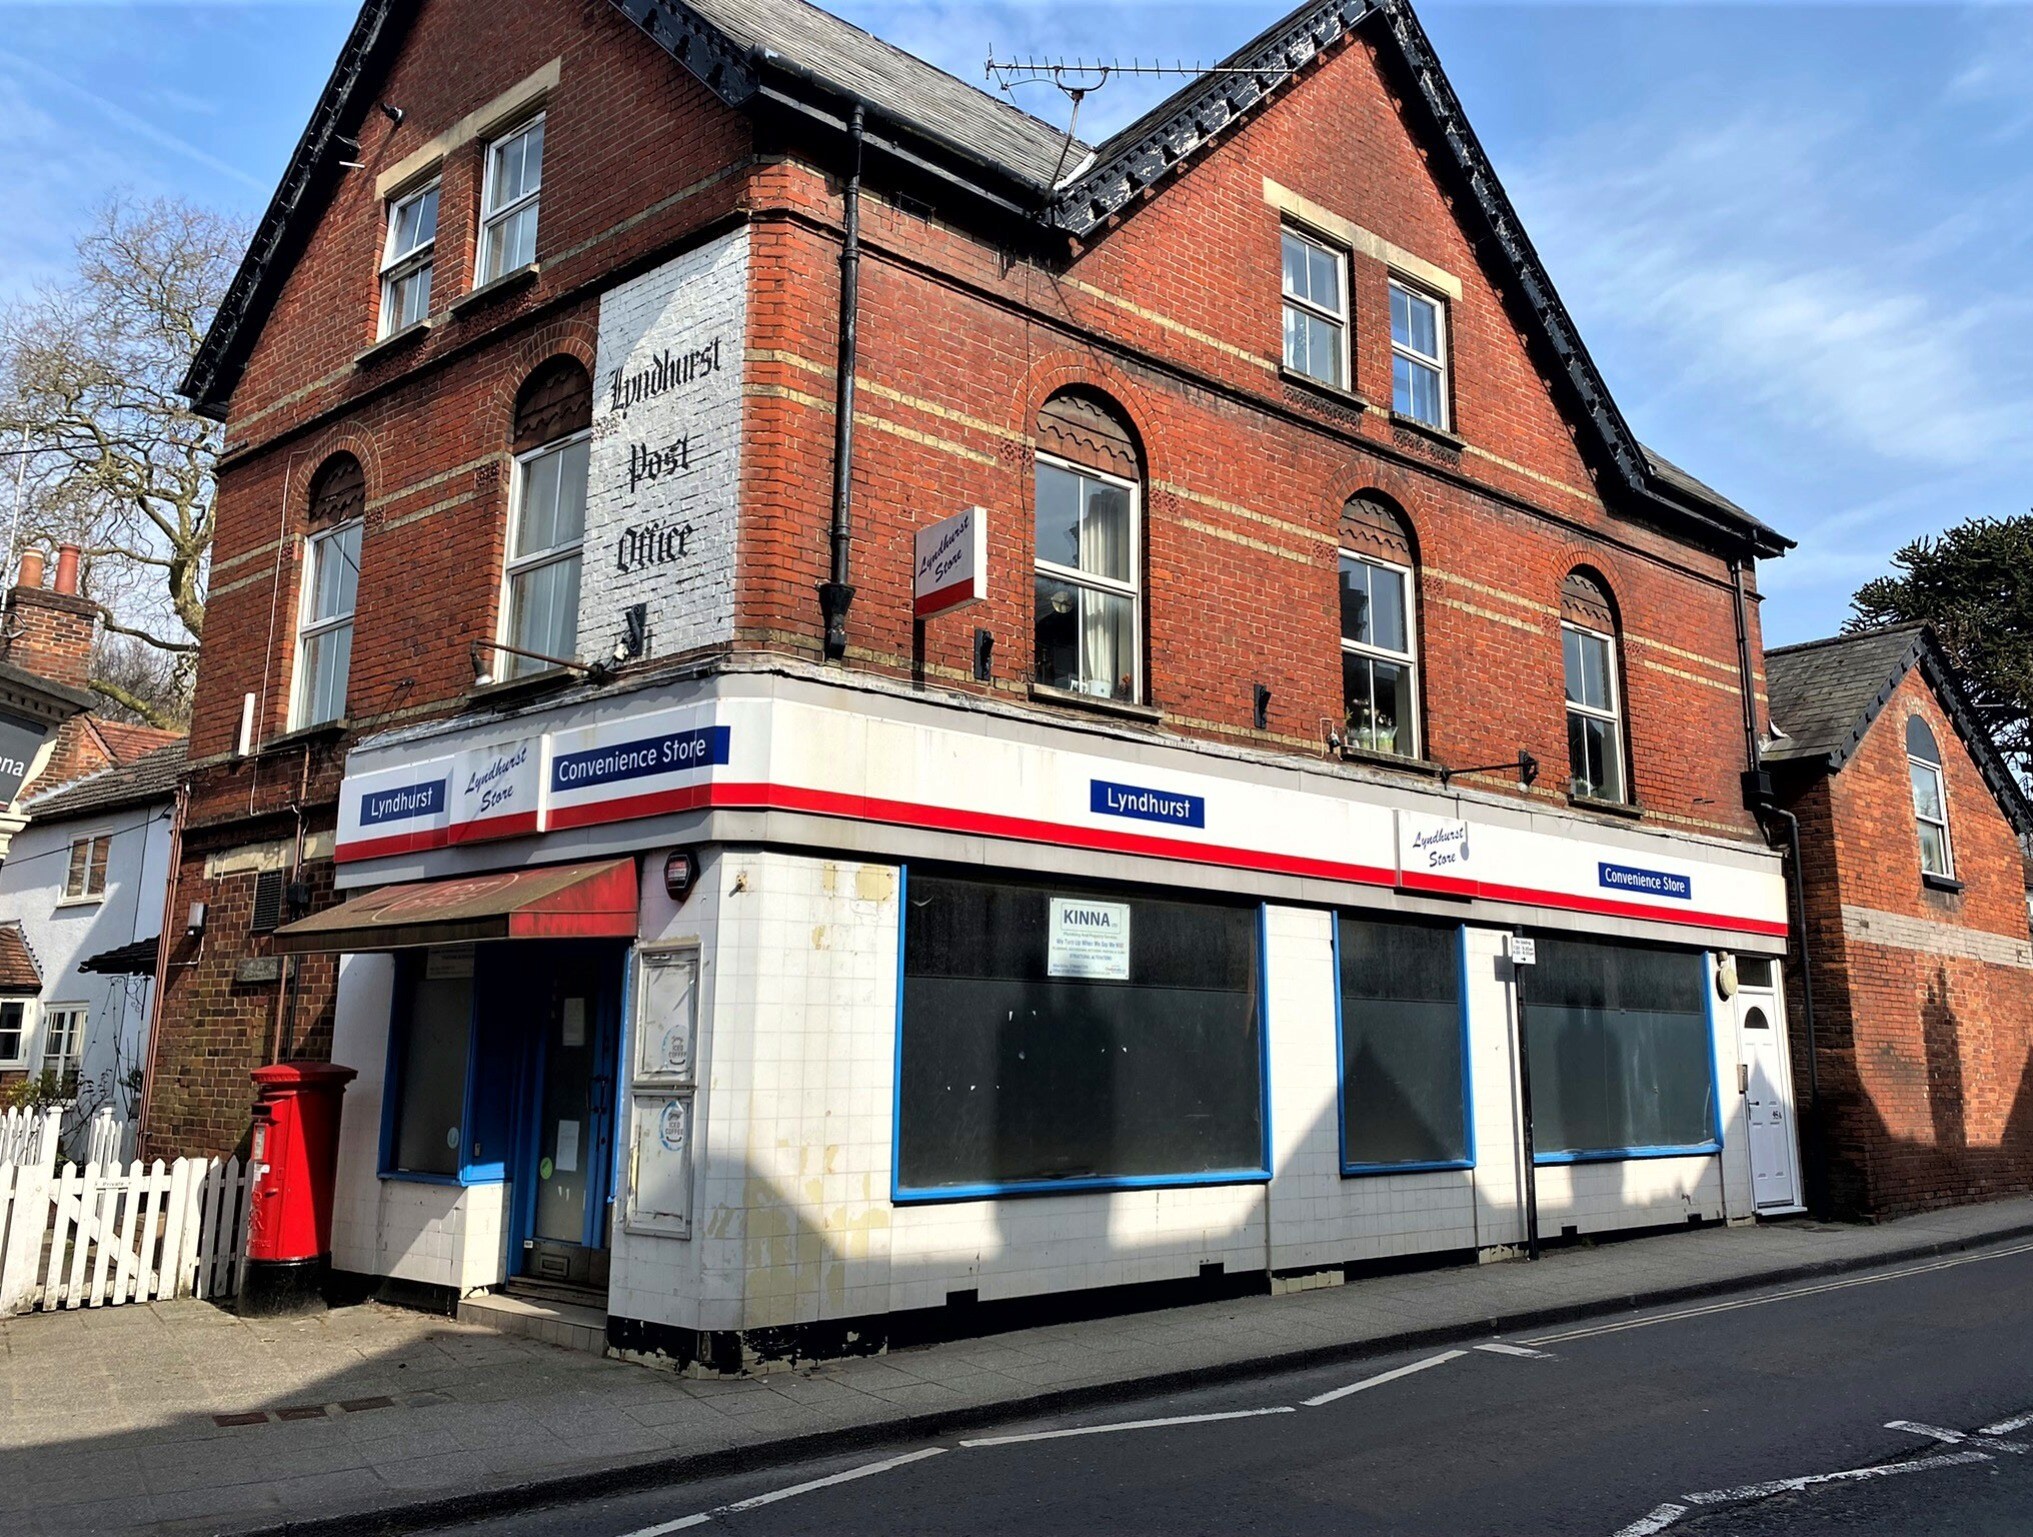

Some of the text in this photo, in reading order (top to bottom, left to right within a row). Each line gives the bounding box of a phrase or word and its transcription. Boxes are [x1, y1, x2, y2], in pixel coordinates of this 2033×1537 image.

[609, 336, 722, 420] Lyndhurst
[628, 432, 690, 494] Post
[617, 519, 694, 572] Office
[919, 515, 969, 578] Lyndhurst
[934, 549, 963, 584] Store
[0, 755, 25, 777] na
[464, 746, 528, 796] Lyndhurst
[558, 738, 706, 782] Convenience Store
[371, 786, 433, 819] Lyndhurst
[480, 784, 514, 813] Store
[1107, 787, 1191, 818] Lyndhurst
[1412, 827, 1464, 850] Lyndhurst
[1429, 850, 1456, 868] Store
[1604, 867, 1686, 893] Convenience Store
[1063, 909, 1111, 927] KINNA
